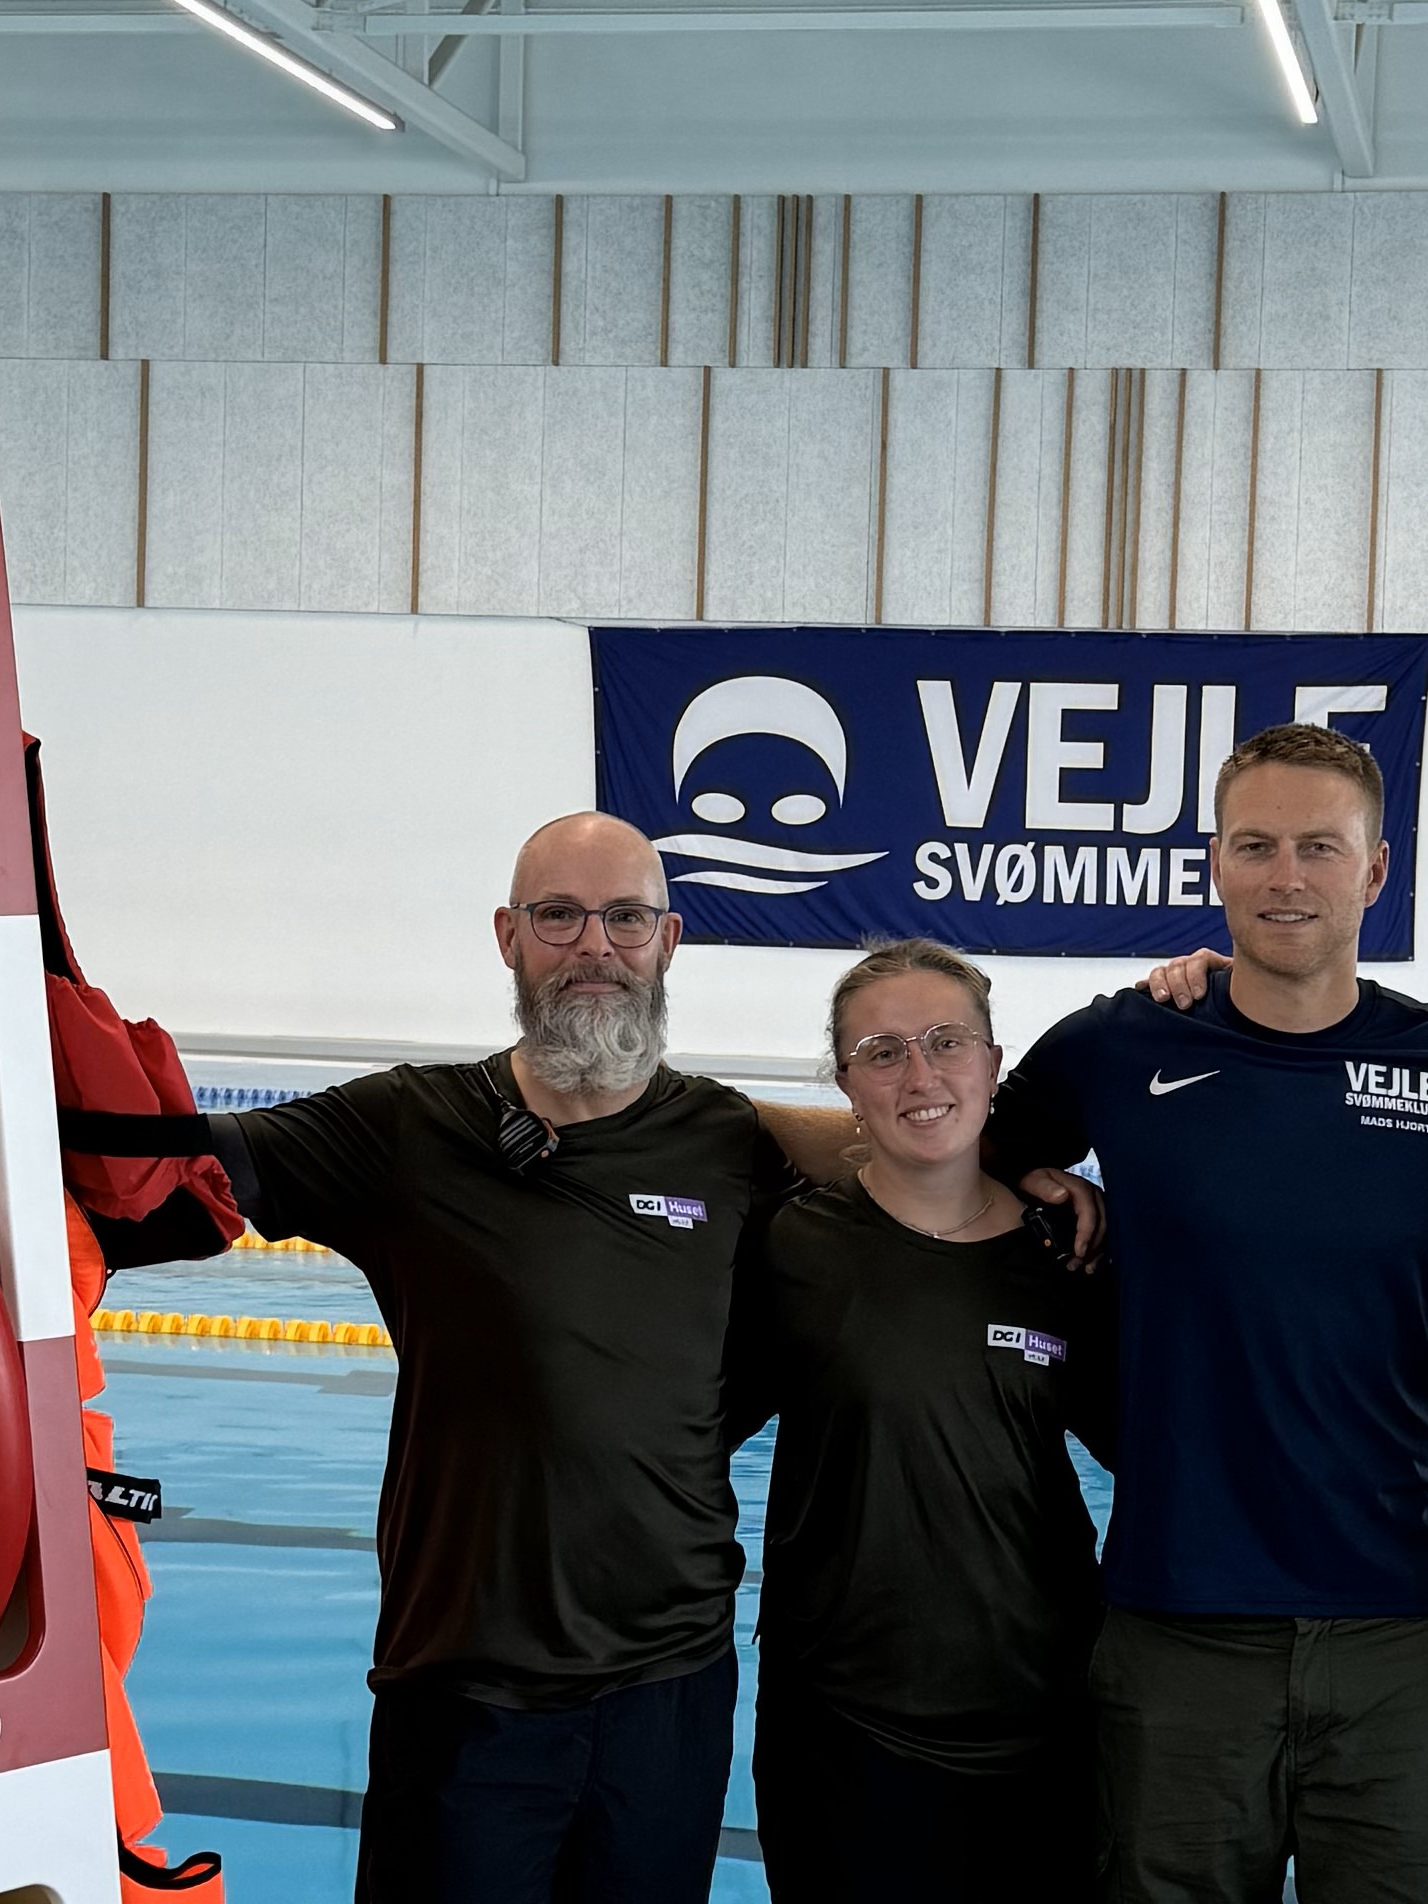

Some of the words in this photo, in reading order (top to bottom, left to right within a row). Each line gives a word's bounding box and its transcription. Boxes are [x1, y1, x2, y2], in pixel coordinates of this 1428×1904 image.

[913, 840, 1224, 907] SVØMME
[1360, 1115, 1393, 1128] MADS
[636, 1200, 661, 1212] DGI
[992, 1330, 1021, 1343] DGI
[1028, 1334, 1062, 1356] Huset
